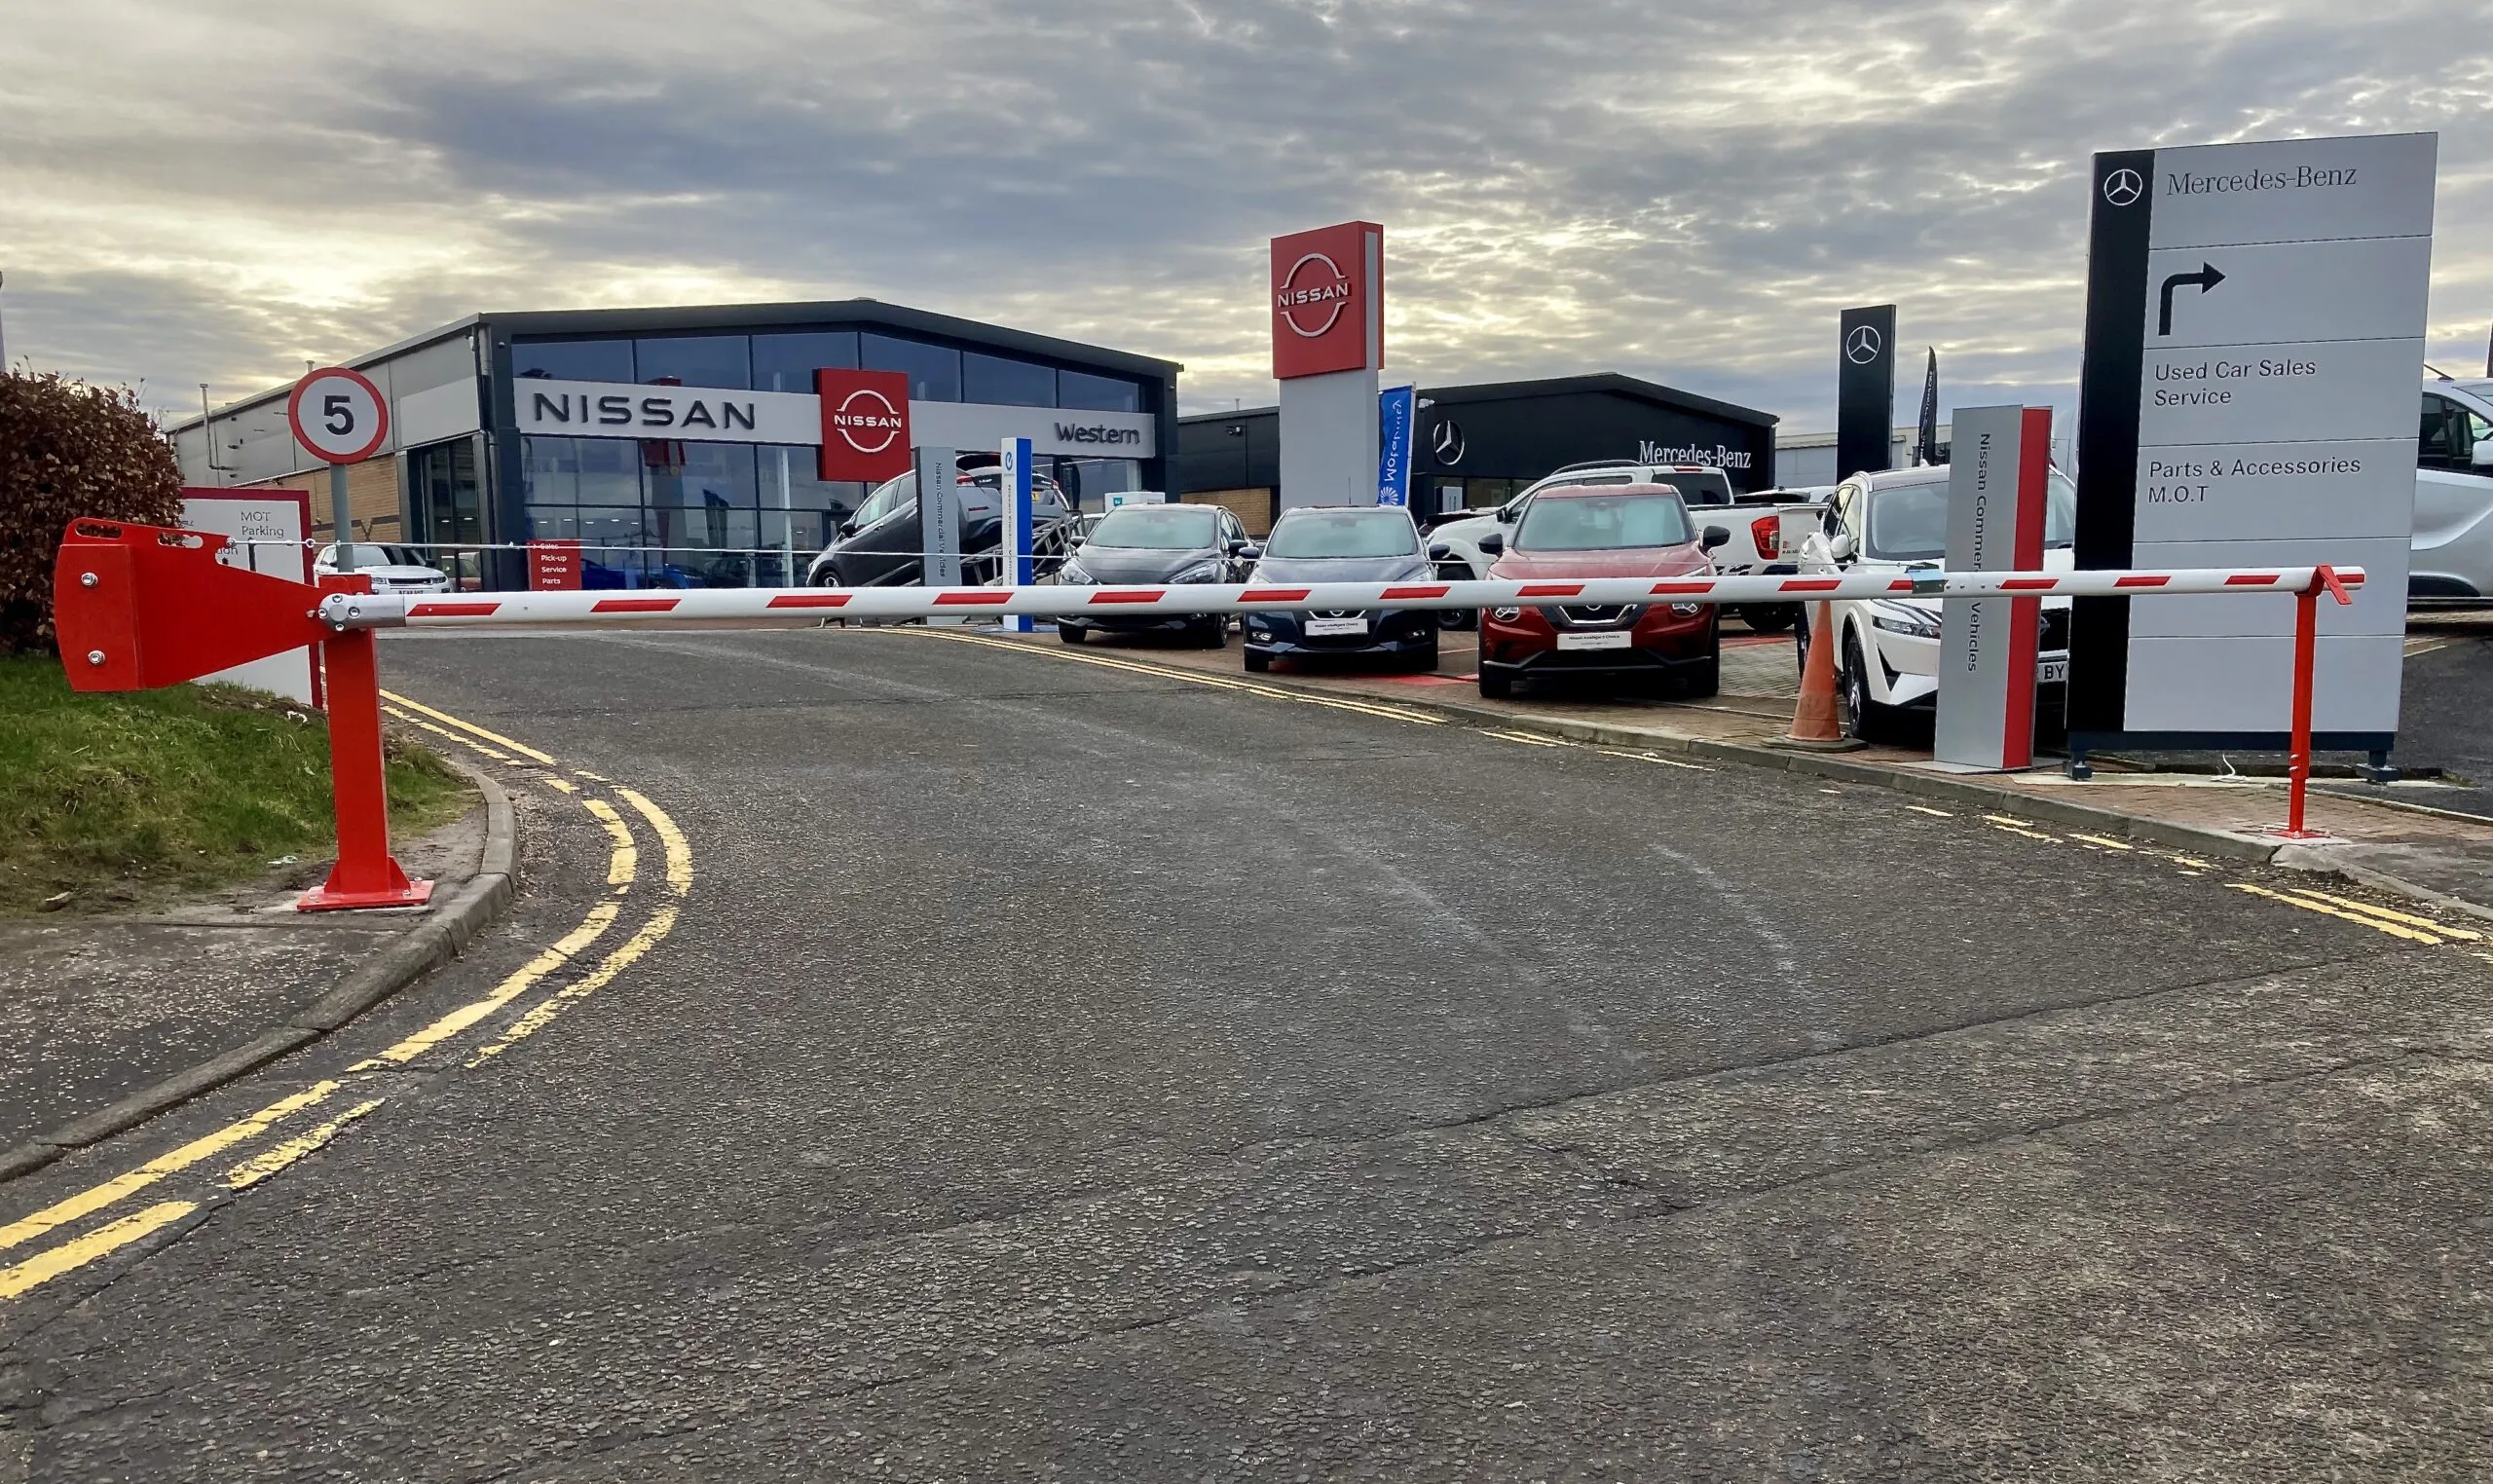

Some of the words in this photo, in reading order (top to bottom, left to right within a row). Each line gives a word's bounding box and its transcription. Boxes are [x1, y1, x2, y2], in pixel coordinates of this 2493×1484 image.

[2167, 165, 2358, 196] Mercedes-Benz
[1278, 282, 1350, 308] NISSAN
[2155, 361, 2208, 381] Used
[2215, 361, 2252, 379] Car
[2258, 358, 2317, 377] Sales
[2154, 388, 2232, 407] Service
[323, 395, 354, 435] 5
[534, 392, 755, 430] NISSAN
[835, 415, 902, 428] NISSAN
[1055, 422, 1140, 445] Western
[1639, 440, 1751, 468] Mercedes-Benz
[1977, 433, 1991, 491] Nissan
[2149, 461, 2203, 478] Parts
[2210, 460, 2223, 477] &
[2231, 456, 2362, 477] Accessories
[2148, 485, 2210, 504] M.O.T
[241, 511, 271, 522] MOT
[242, 526, 284, 538] Parking
[1973, 495, 1988, 573] Commer
[1967, 602, 1982, 672] Vehicles
